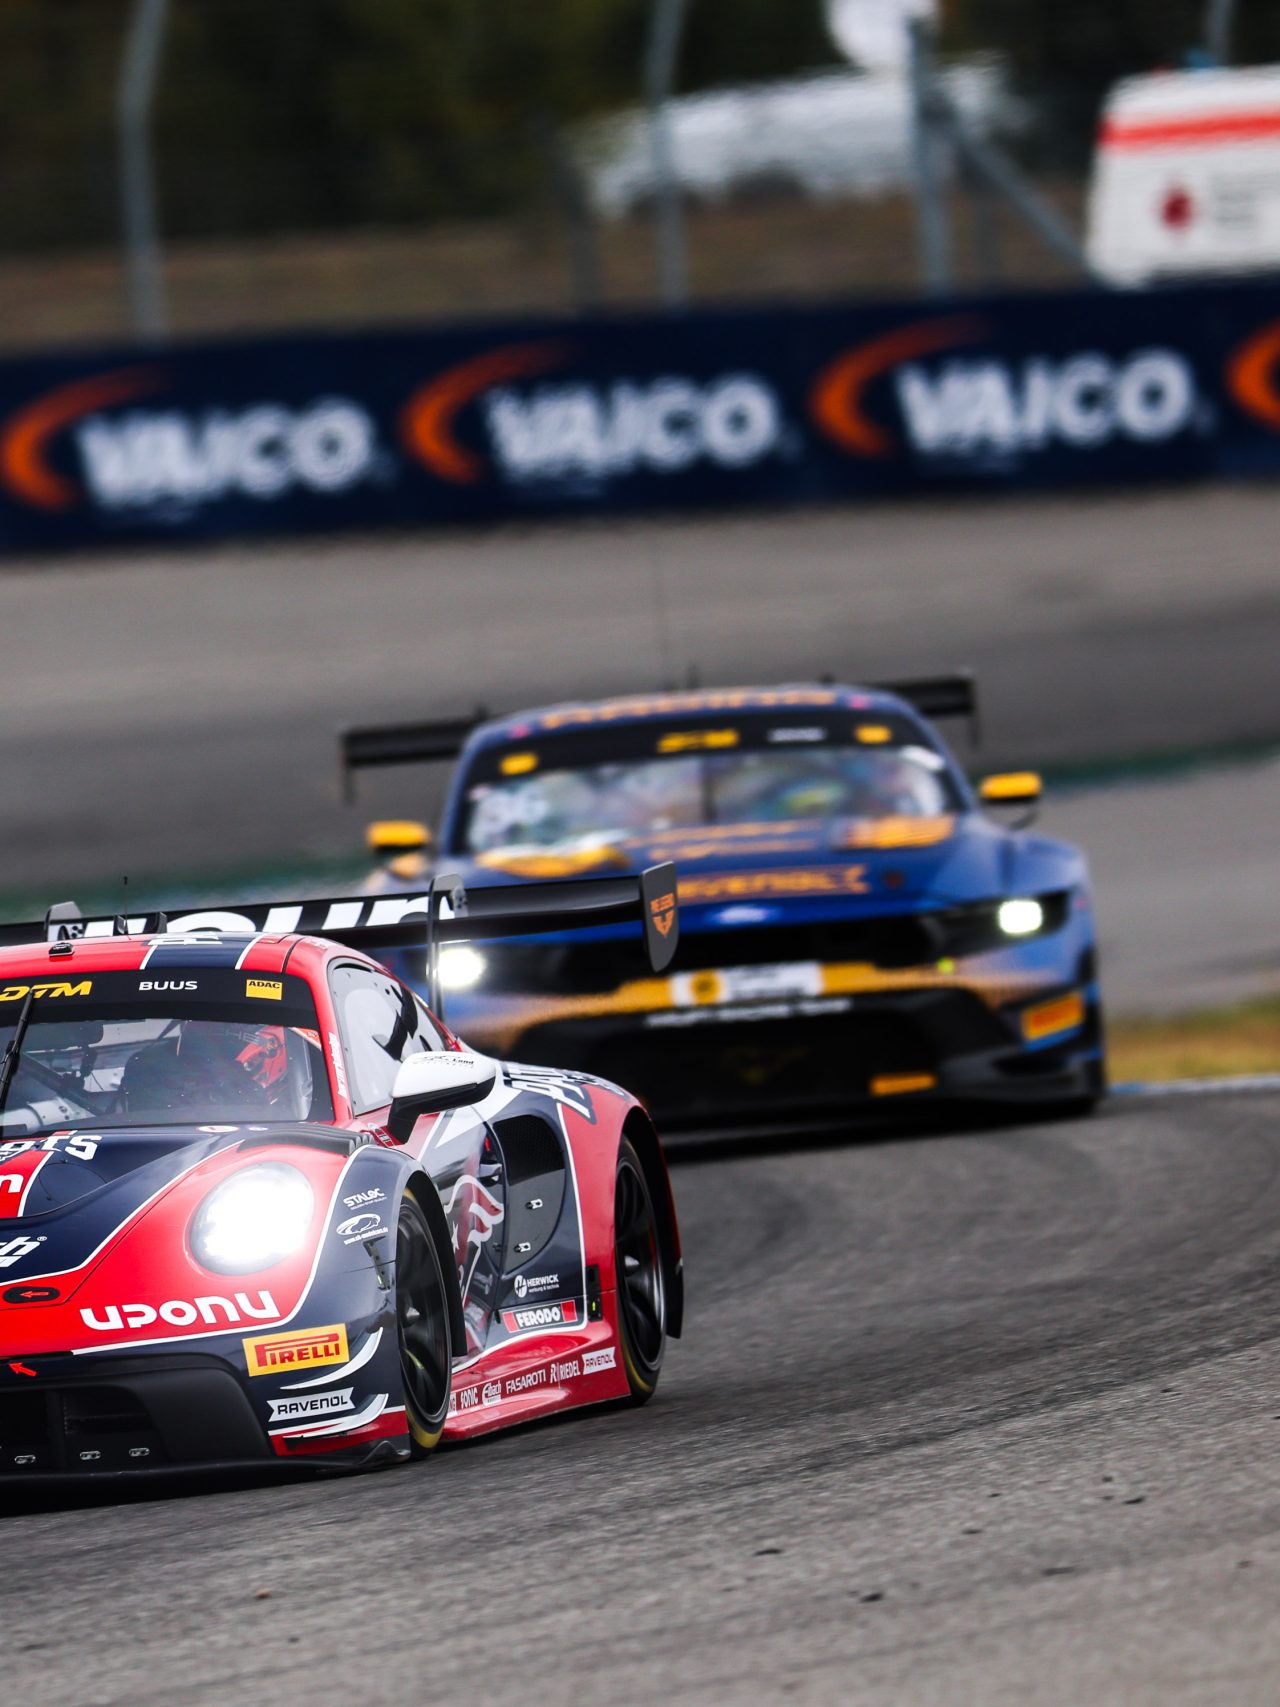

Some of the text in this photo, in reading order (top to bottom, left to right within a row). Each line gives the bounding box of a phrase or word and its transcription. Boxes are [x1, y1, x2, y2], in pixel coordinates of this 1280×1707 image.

[138, 980, 198, 991] BUUS
[249, 981, 280, 989] ADAC
[527, 1274, 560, 1287] HERWICK
[515, 1307, 561, 1328] FERODO
[255, 1333, 340, 1367] PIRELLI
[277, 1395, 348, 1415] RAVENOL
